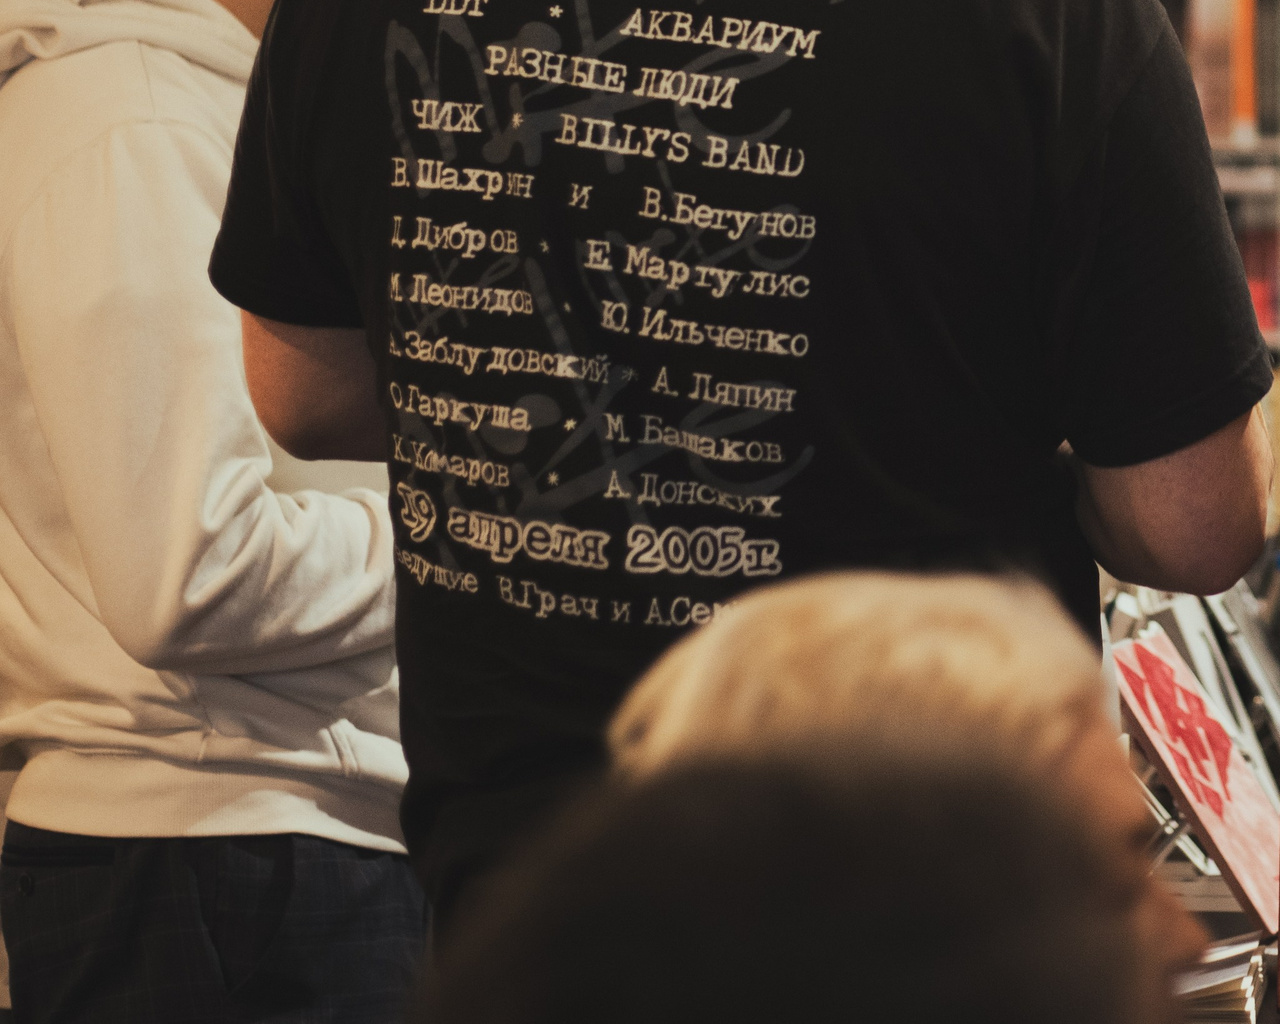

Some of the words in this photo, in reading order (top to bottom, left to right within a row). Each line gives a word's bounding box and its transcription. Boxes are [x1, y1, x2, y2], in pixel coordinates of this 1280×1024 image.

[619, 8, 820, 58] АКВАРИУМ
[484, 45, 627, 93] РАЗНЫЕ
[637, 66, 740, 109] ЛЮДИ
[412, 99, 483, 132] ЧИЖ
[555, 113, 691, 162] BILLY'S
[702, 135, 804, 177] BAND
[570, 184, 592, 209] и
[411, 217, 517, 258] Дибров
[409, 274, 532, 315] Леонидов
[639, 306, 808, 356] Ильченко
[404, 330, 610, 384] Заблудовский
[652, 366, 678, 396] А.
[689, 373, 796, 411] Ляпин
[604, 413, 629, 442] М.
[637, 414, 783, 463] Башаков
[603, 471, 629, 498] А.
[637, 474, 782, 517] Донских
[397, 481, 438, 542] 19
[447, 507, 610, 569] апреля
[613, 601, 630, 622] и
[643, 596, 723, 628] А.Се
